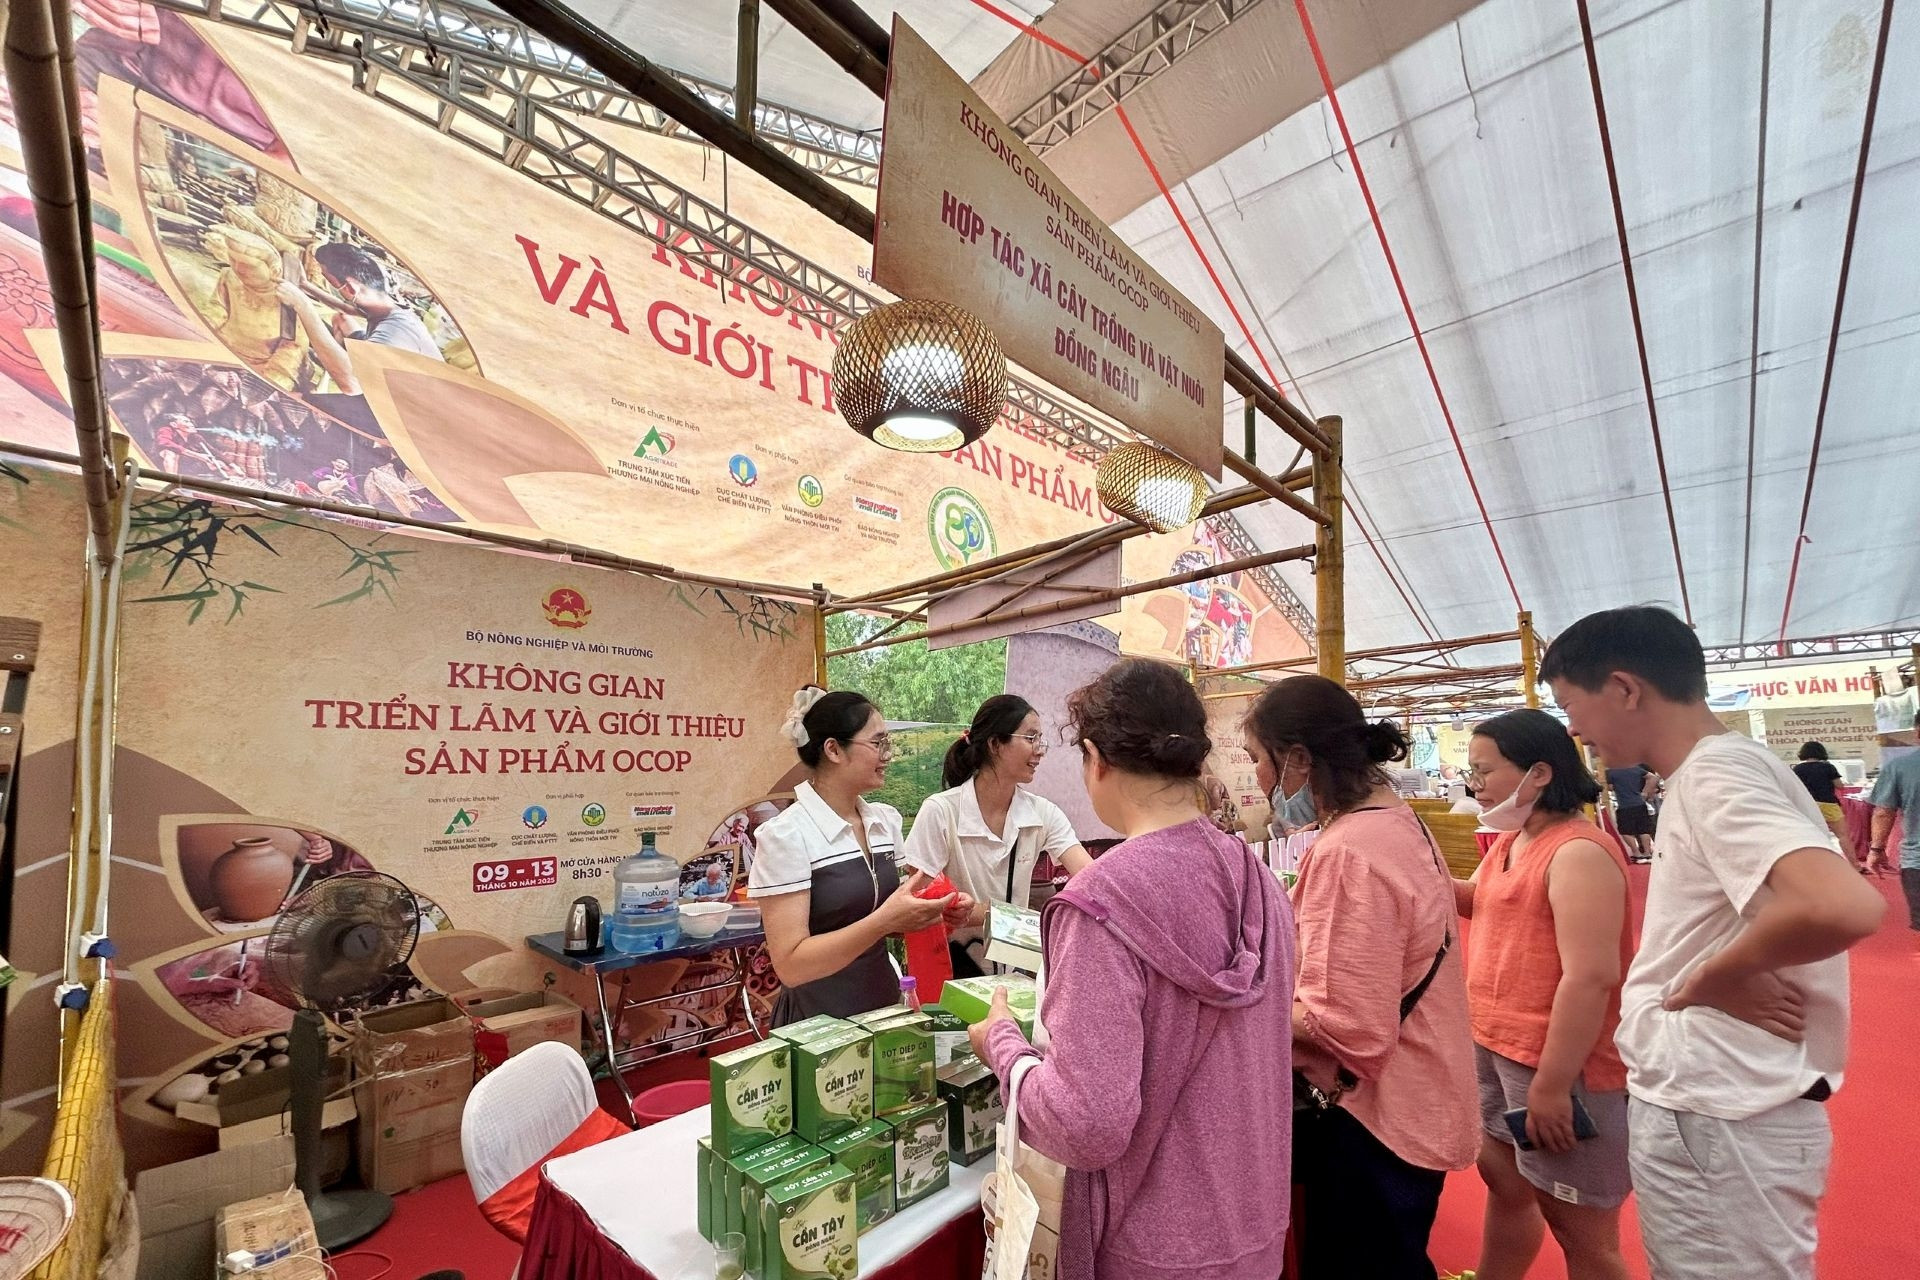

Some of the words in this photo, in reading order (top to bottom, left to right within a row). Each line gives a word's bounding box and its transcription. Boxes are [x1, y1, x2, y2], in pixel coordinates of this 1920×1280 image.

[960, 100, 1022, 176] KHÔNG
[1024, 166, 1061, 214] GIAN
[1064, 202, 1101, 250] TRIỂN
[1132, 266, 1148, 291] VÀ
[1046, 215, 1074, 253] SẢN
[1078, 244, 1116, 288] PHẨM
[1118, 279, 1149, 312] OCOP
[515, 234, 629, 335] VÀ
[647, 299, 776, 391] GIỚI
[942, 190, 984, 244] HỢP
[990, 226, 1024, 278] TÁC
[1030, 257, 1052, 300] XÃ
[1058, 280, 1088, 323] CÂY
[1091, 304, 1136, 358] TRỒNG
[1140, 340, 1156, 372] VÀ
[1158, 353, 1179, 388] VẬT
[1182, 370, 1204, 408] NUÔI
[1055, 326, 1097, 378] ĐỒNG
[618, 460, 642, 472] TRUNG
[644, 466, 659, 476] TÂM
[660, 471, 674, 480] XÚC
[676, 475, 690, 485] TIẾN
[1009, 453, 1093, 518] PHẨM
[466, 630, 484, 644] BỘ
[487, 632, 522, 646] NÔNG
[526, 636, 568, 652] NGHIỆP
[571, 638, 586, 652] VÀ
[588, 640, 608, 654] MÔI
[611, 643, 654, 660] TRƯỜNG
[446, 661, 582, 695] KHÔNG
[588, 673, 666, 700] GIAN
[1795, 676, 1838, 694] VĂN
[305, 693, 440, 732] TRIỂN
[450, 704, 536, 734] LÃM
[546, 704, 592, 734] VÀ
[599, 708, 660, 737] GIỚI
[666, 712, 746, 743] THIỆU
[1784, 718, 1822, 726] KHÔNG
[1824, 718, 1852, 726] GIAN
[404, 740, 489, 776] SẢN
[498, 740, 605, 774] PHẨM
[612, 749, 692, 774] OCOP
[476, 864, 509, 882] 09
[531, 860, 554, 876] 13
[560, 859, 574, 868] MỞ
[578, 857, 595, 866] CỬA
[598, 856, 620, 864] HÀNG
[572, 868, 601, 880] 8h30
[476, 882, 506, 891] THÁNG
[520, 879, 536, 887] NĂM
[762, 1078, 782, 1096] TÂY
[847, 1068, 864, 1084] TÂY
[822, 1215, 845, 1236] TÂY
